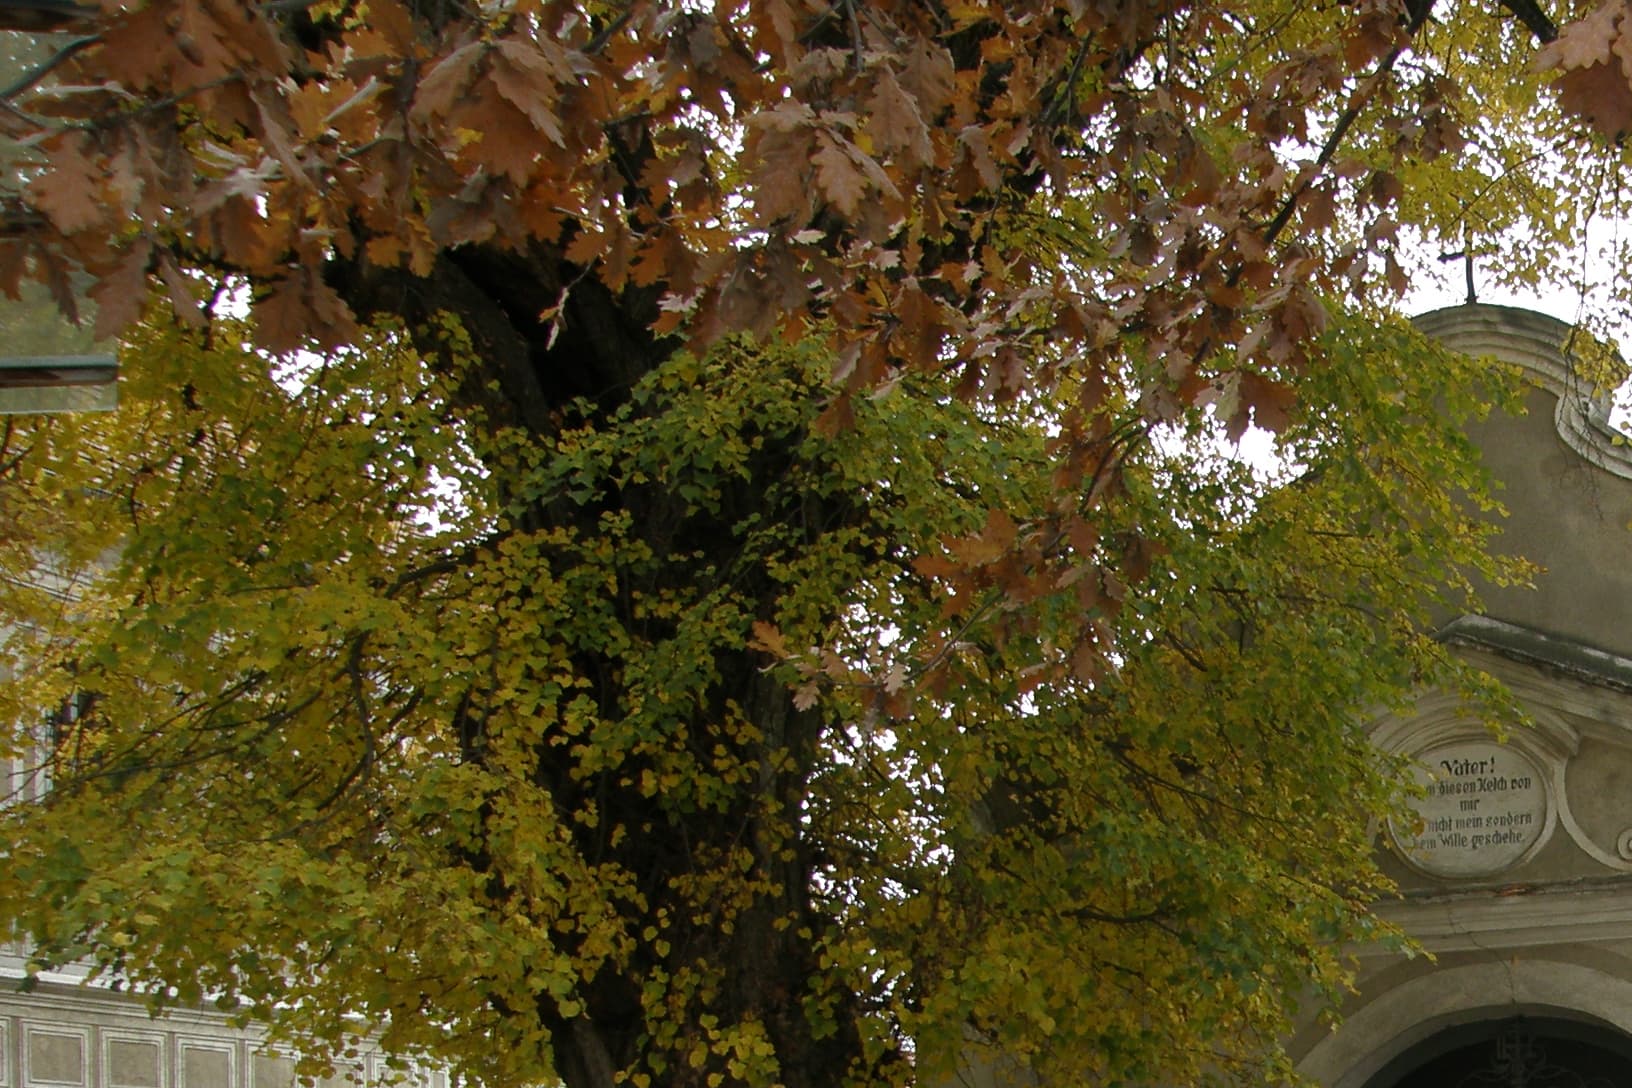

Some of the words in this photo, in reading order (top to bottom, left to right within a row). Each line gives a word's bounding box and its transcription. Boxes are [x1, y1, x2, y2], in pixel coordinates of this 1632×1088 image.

[1440, 780, 1476, 795] diesen
[1476, 777, 1507, 793] Kelch
[1511, 776, 1532, 790] von
[1460, 799, 1479, 812] mir
[1428, 816, 1452, 833] nicht
[1456, 816, 1483, 829] mein
[1486, 811, 1532, 828] sondern
[1439, 832, 1468, 848] Wille
